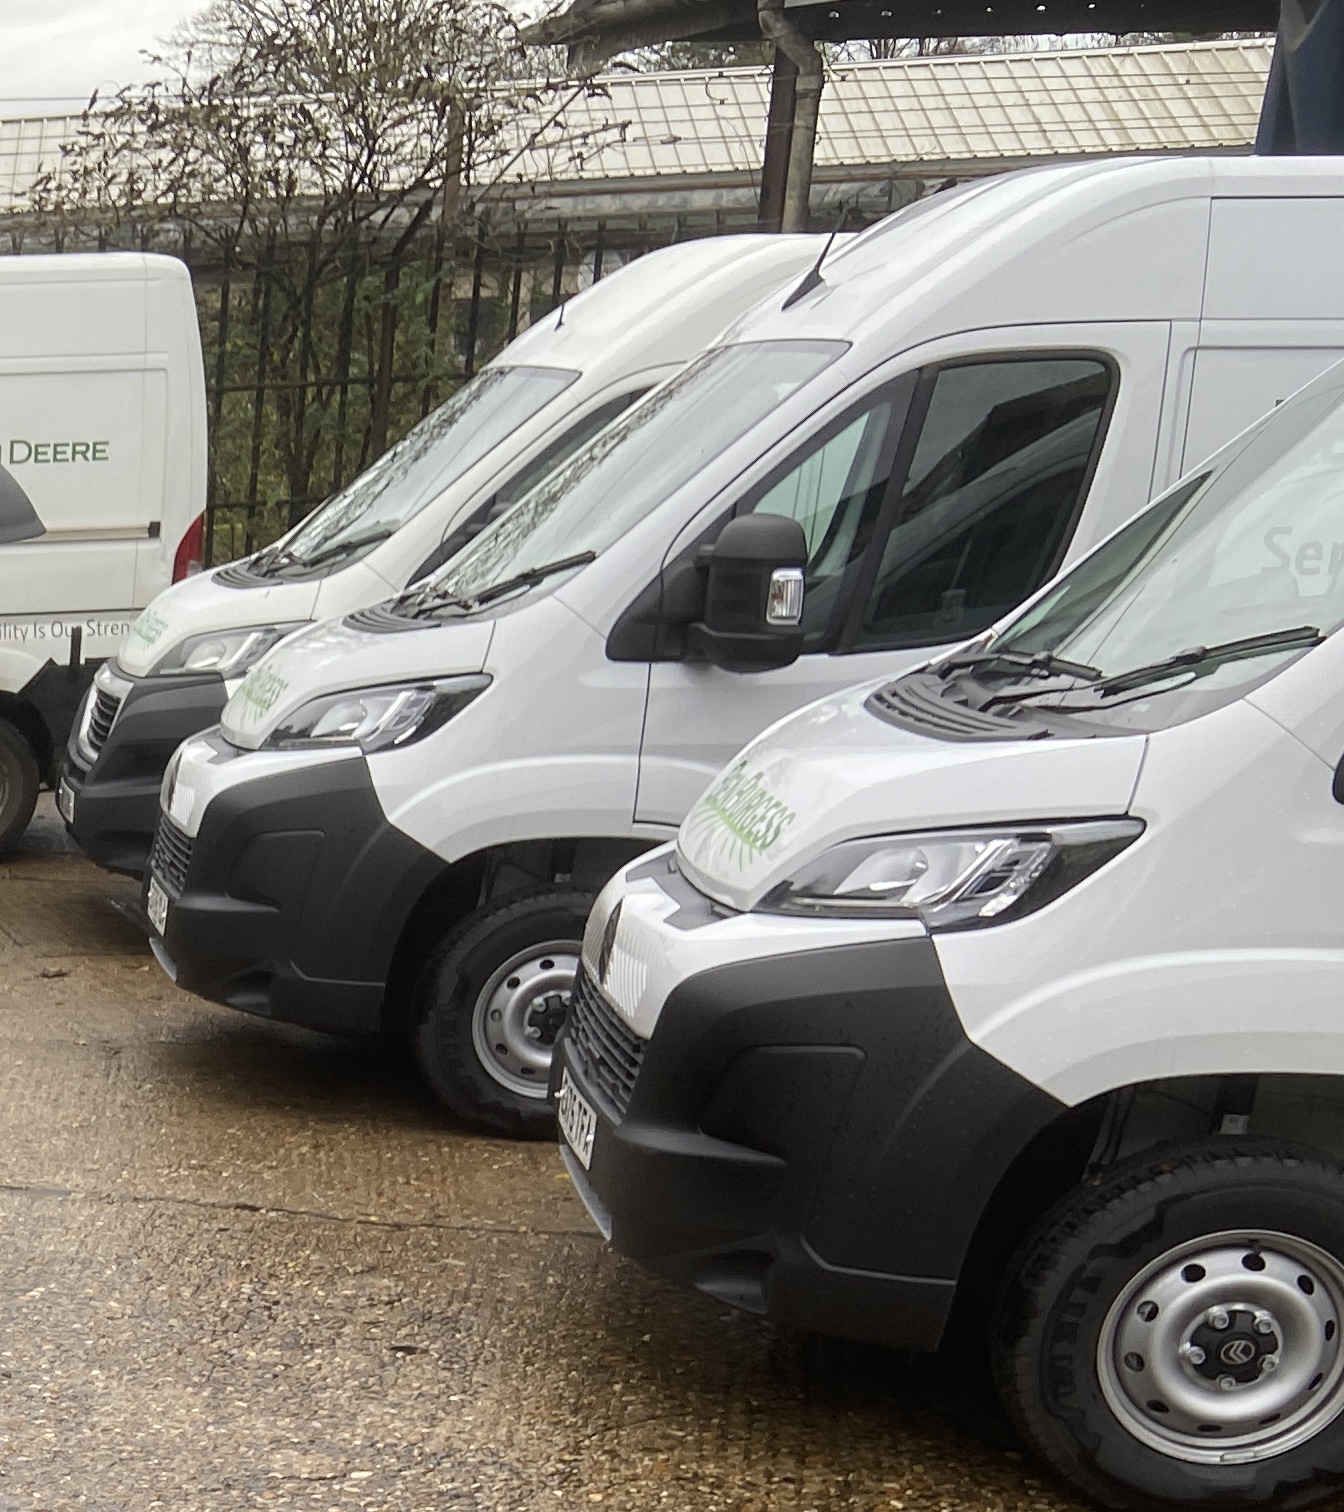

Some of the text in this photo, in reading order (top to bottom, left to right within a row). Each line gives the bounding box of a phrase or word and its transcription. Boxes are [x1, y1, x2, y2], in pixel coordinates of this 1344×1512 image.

[9, 440, 110, 465] DEERE
[51, 619, 73, 639] Ou
[86, 618, 131, 638] Stren
